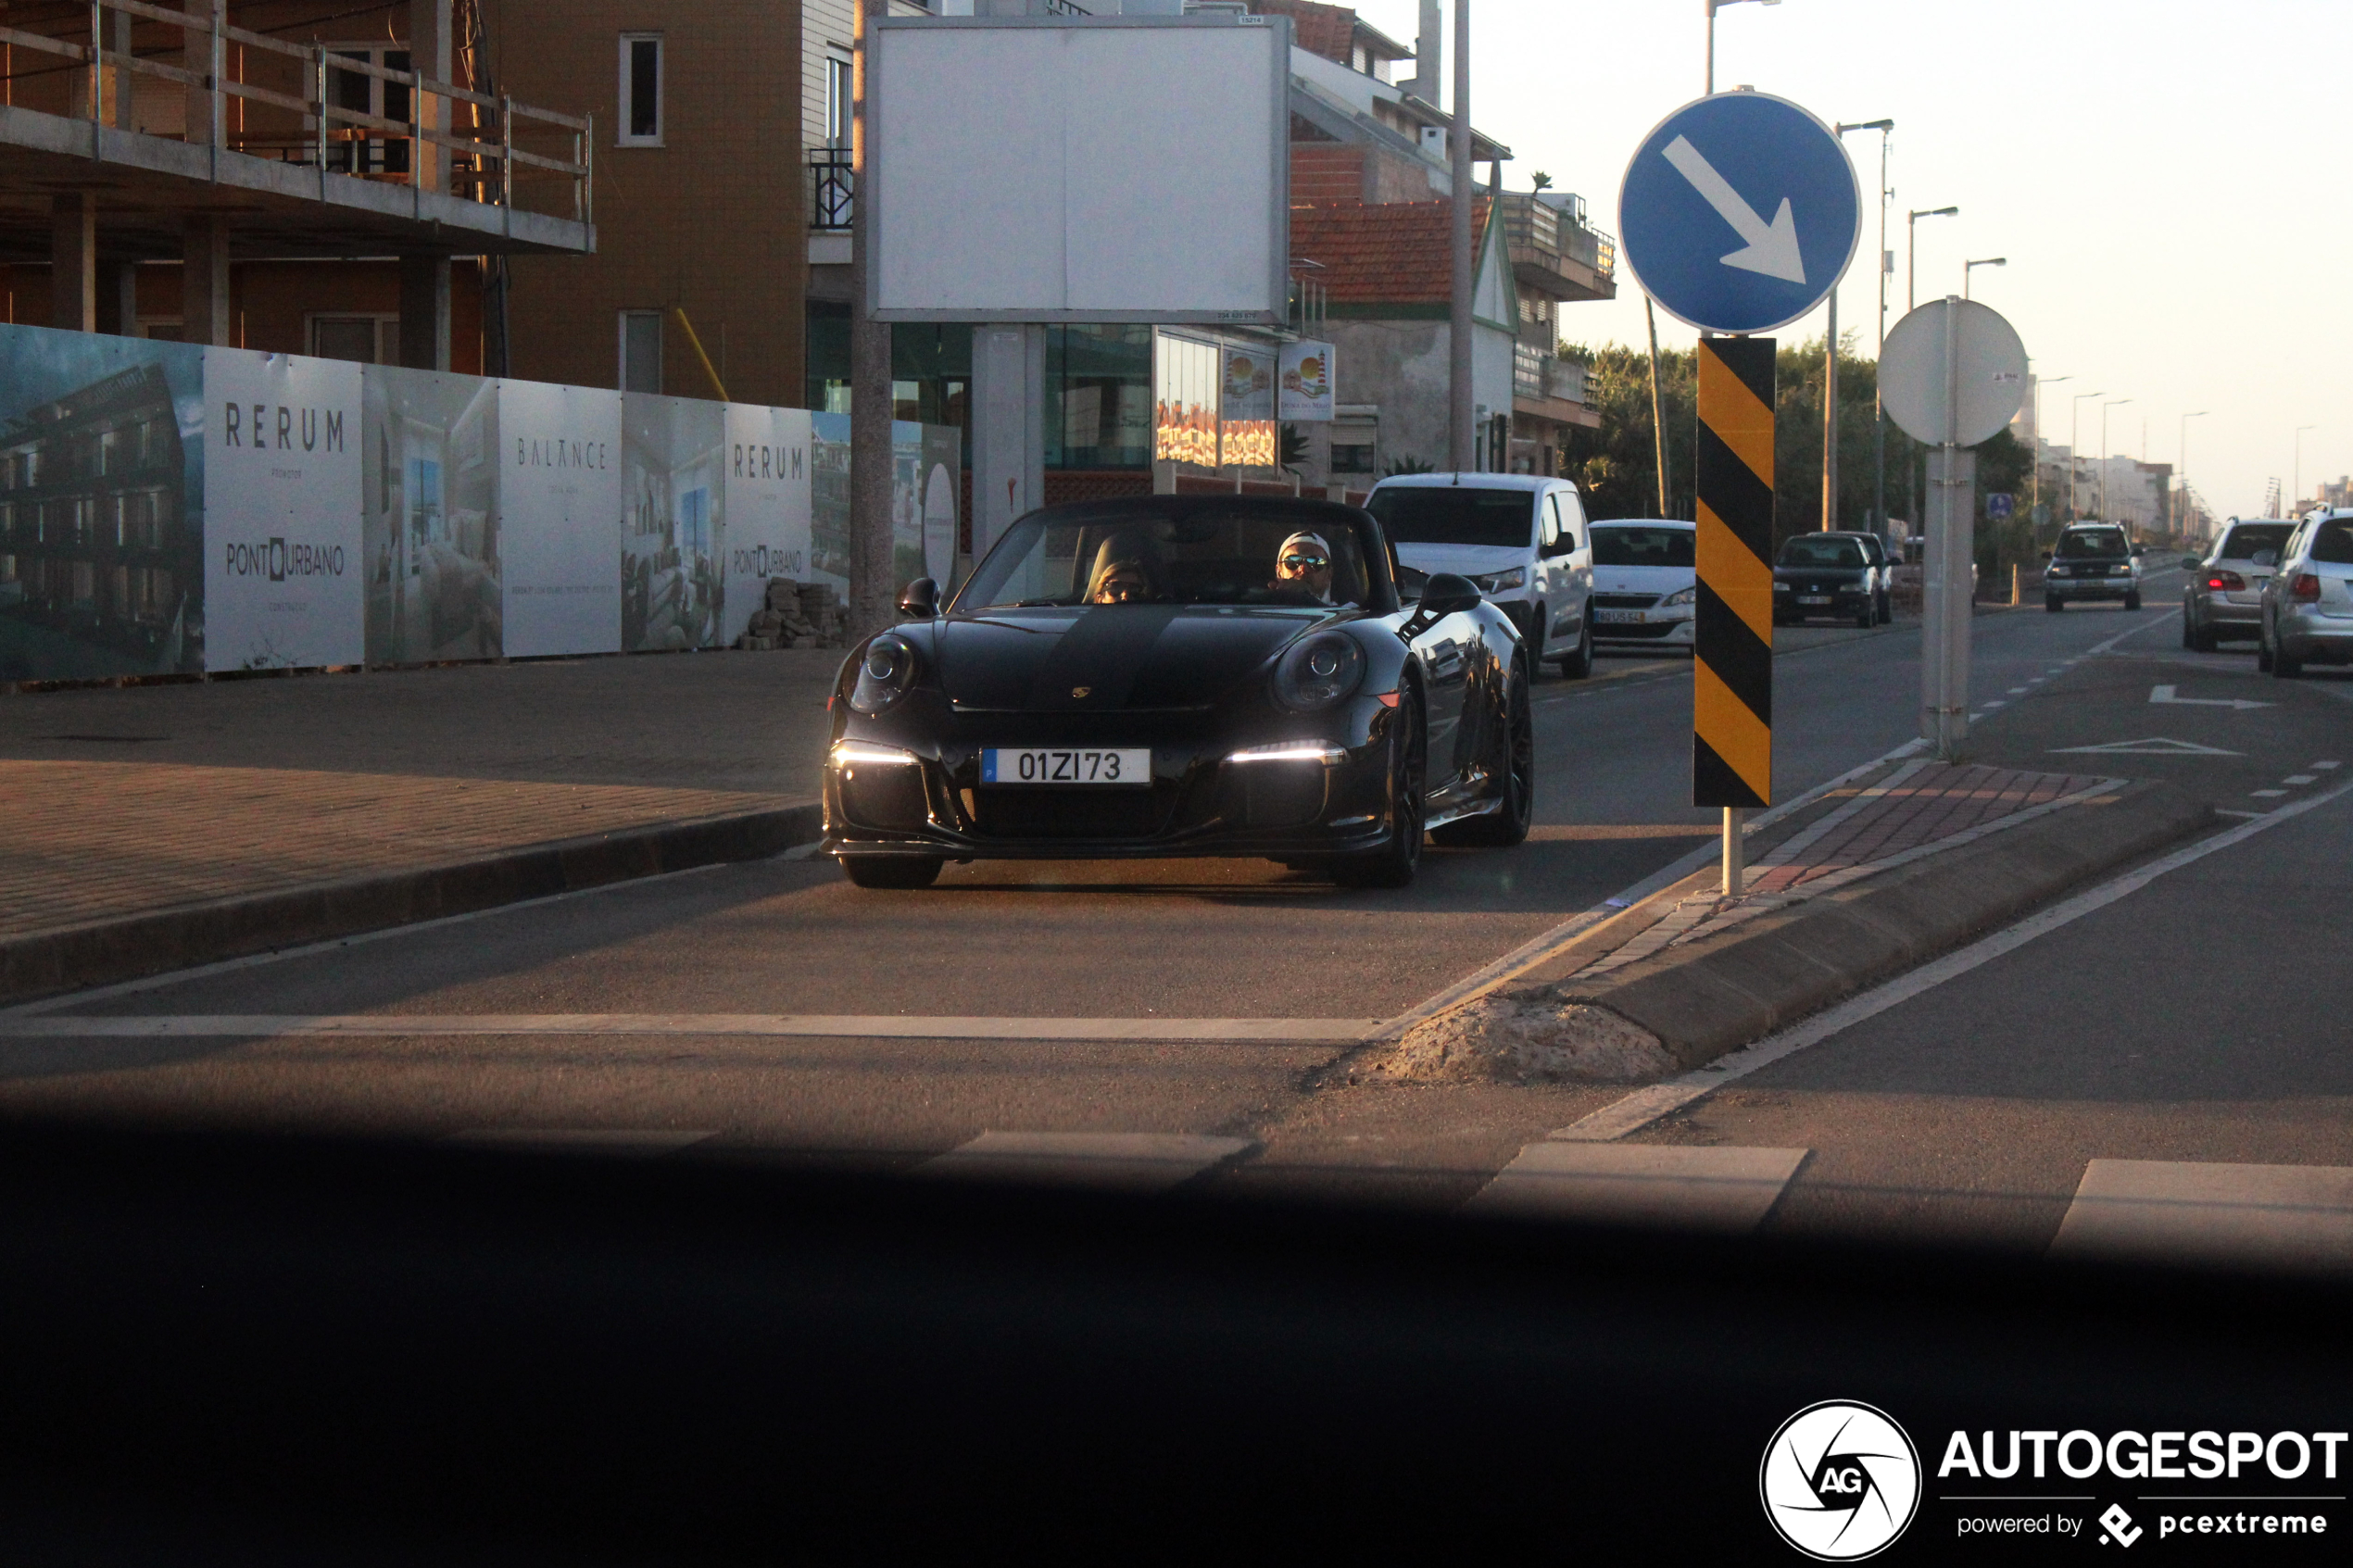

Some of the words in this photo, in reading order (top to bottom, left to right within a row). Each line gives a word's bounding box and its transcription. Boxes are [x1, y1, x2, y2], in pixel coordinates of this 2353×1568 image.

[226, 402, 344, 453] RERUM
[735, 444, 802, 480] RERUM
[227, 537, 345, 582] PONTOURBANO
[734, 545, 802, 578] PONTOURBANO
[1019, 752, 1121, 781] 01ZI73
